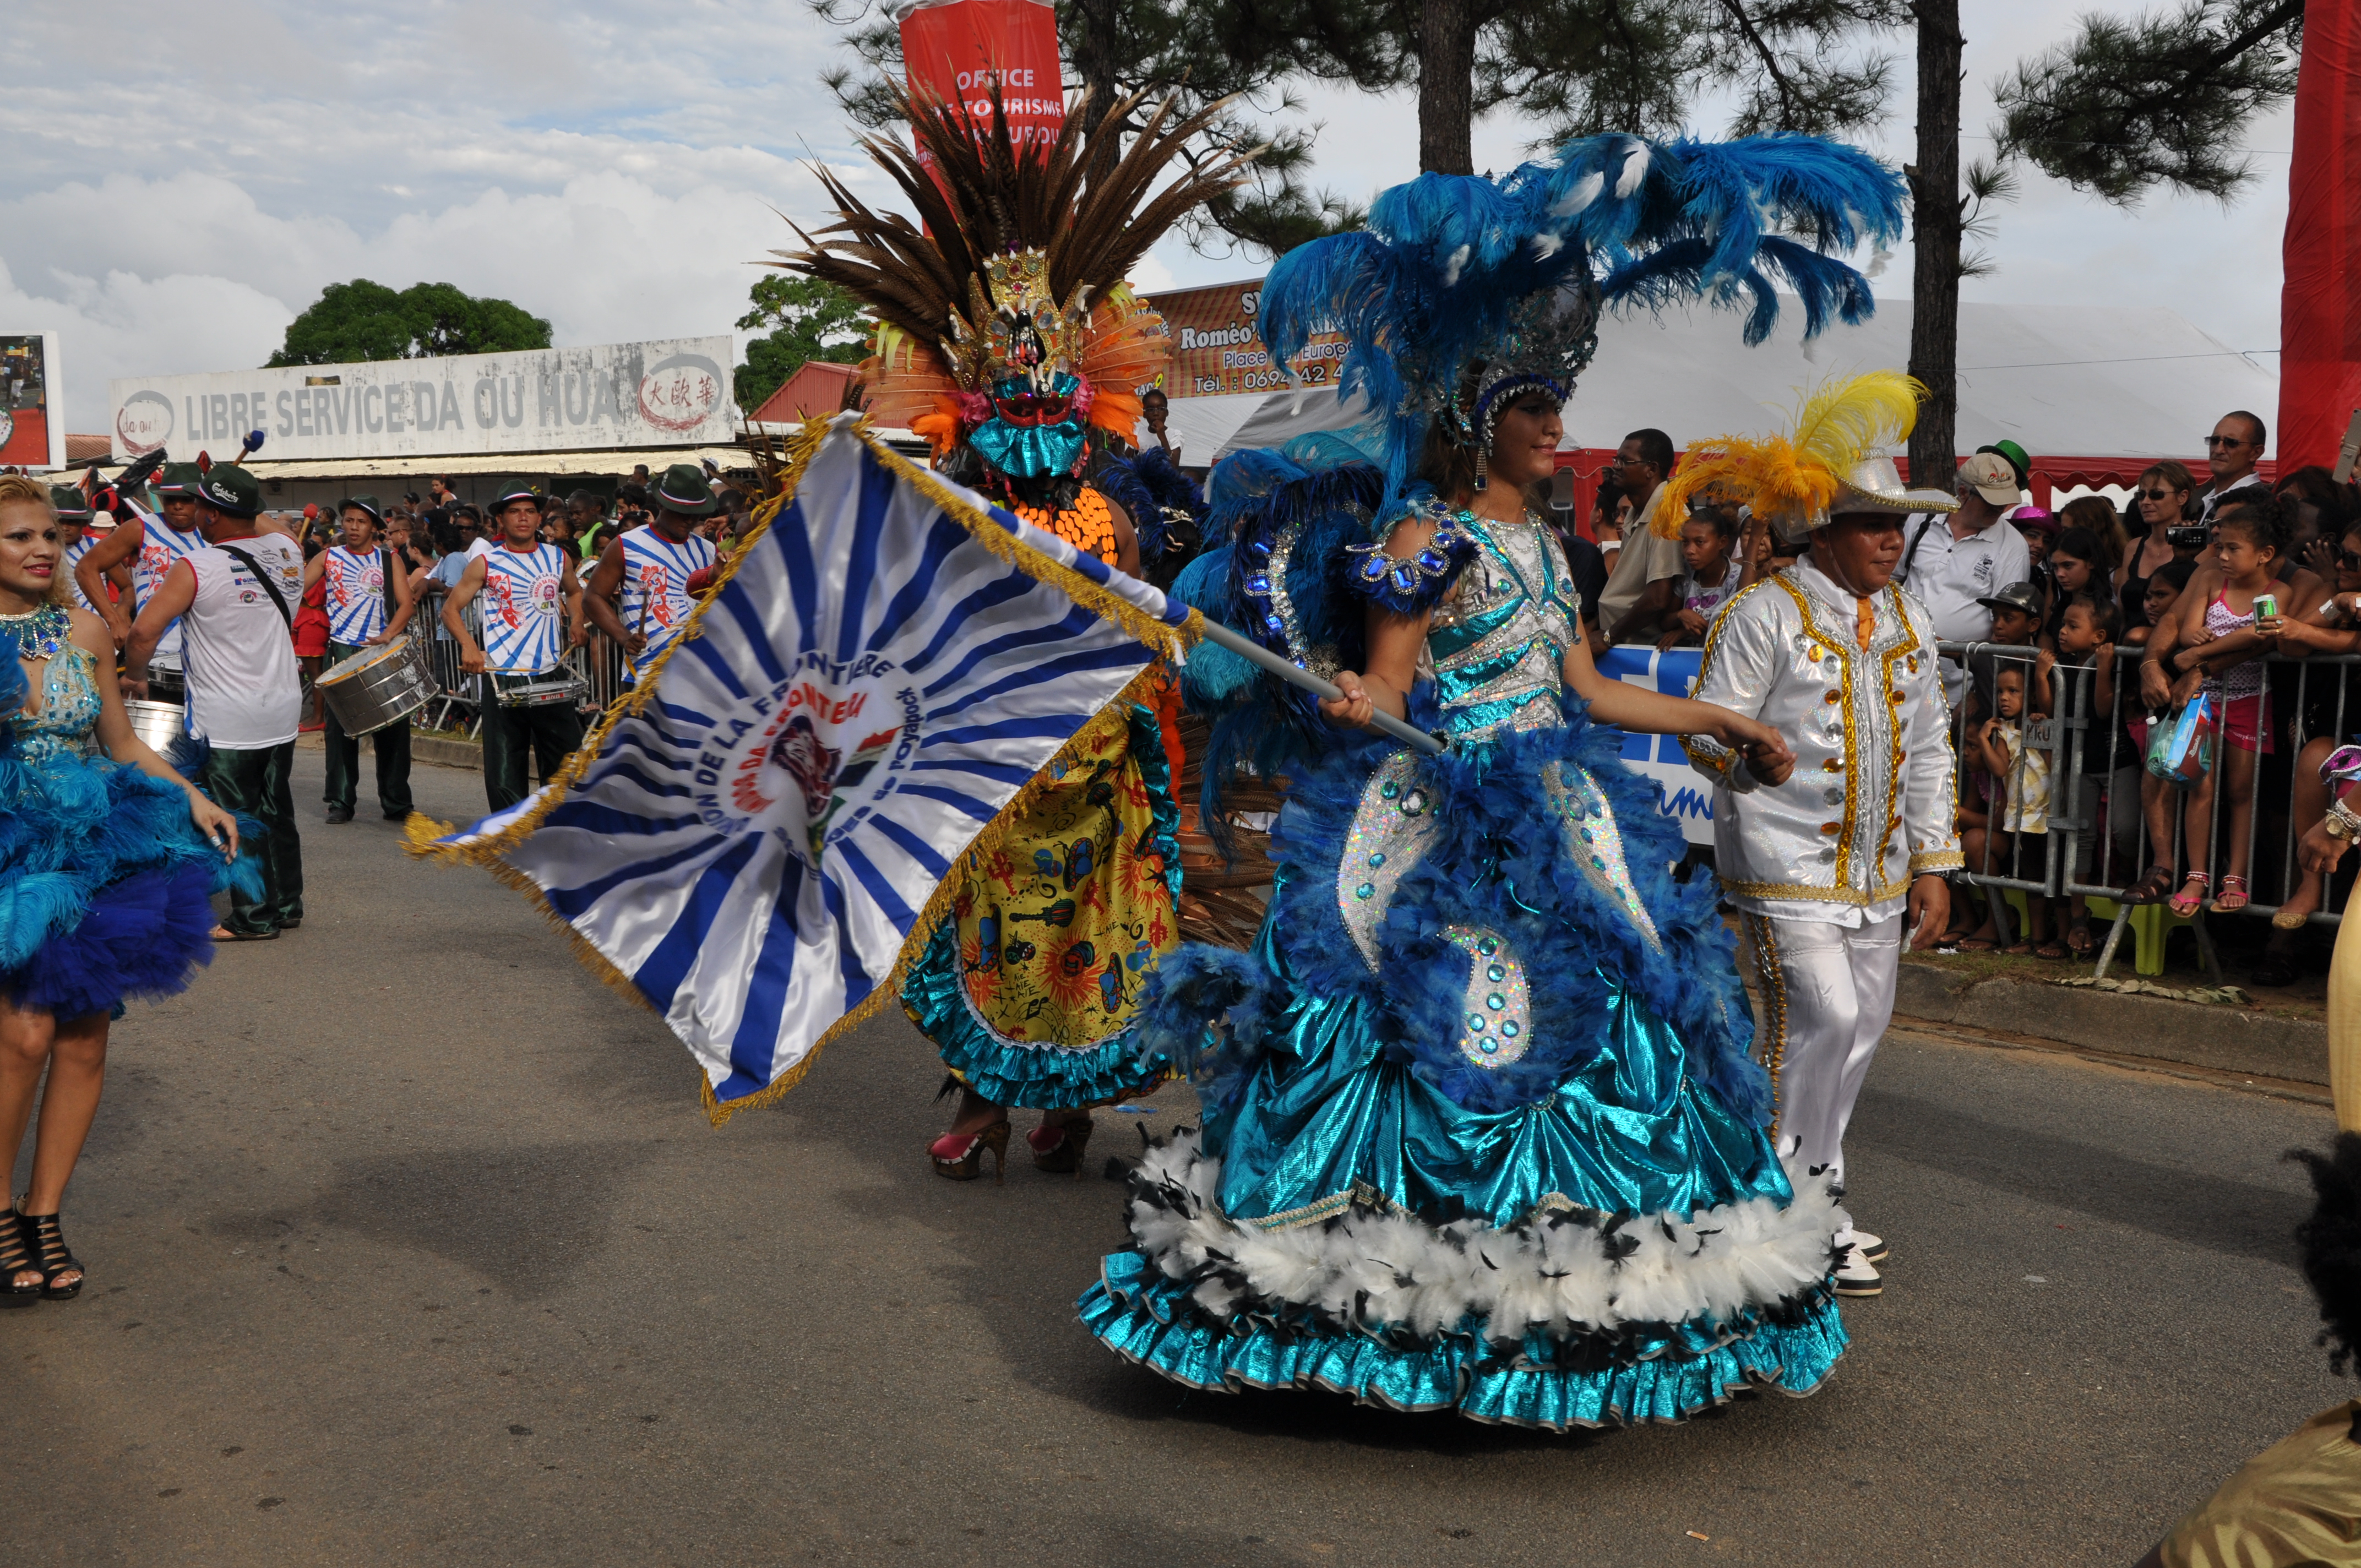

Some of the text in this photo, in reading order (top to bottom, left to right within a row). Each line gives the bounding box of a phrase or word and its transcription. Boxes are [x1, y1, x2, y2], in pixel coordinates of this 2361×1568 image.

[956, 69, 1033, 90] OFFICE
[964, 98, 1062, 118] TOURISME
[1223, 351, 1267, 369] Place
[186, 371, 620, 441] LIBRE SERVICE DA OU HUA
[212, 482, 239, 503] Carlsberg
[529, 580, 537, 598] UNION
[2026, 724, 2050, 742] KRU
[695, 750, 726, 786] DE
[712, 718, 755, 750] LA
